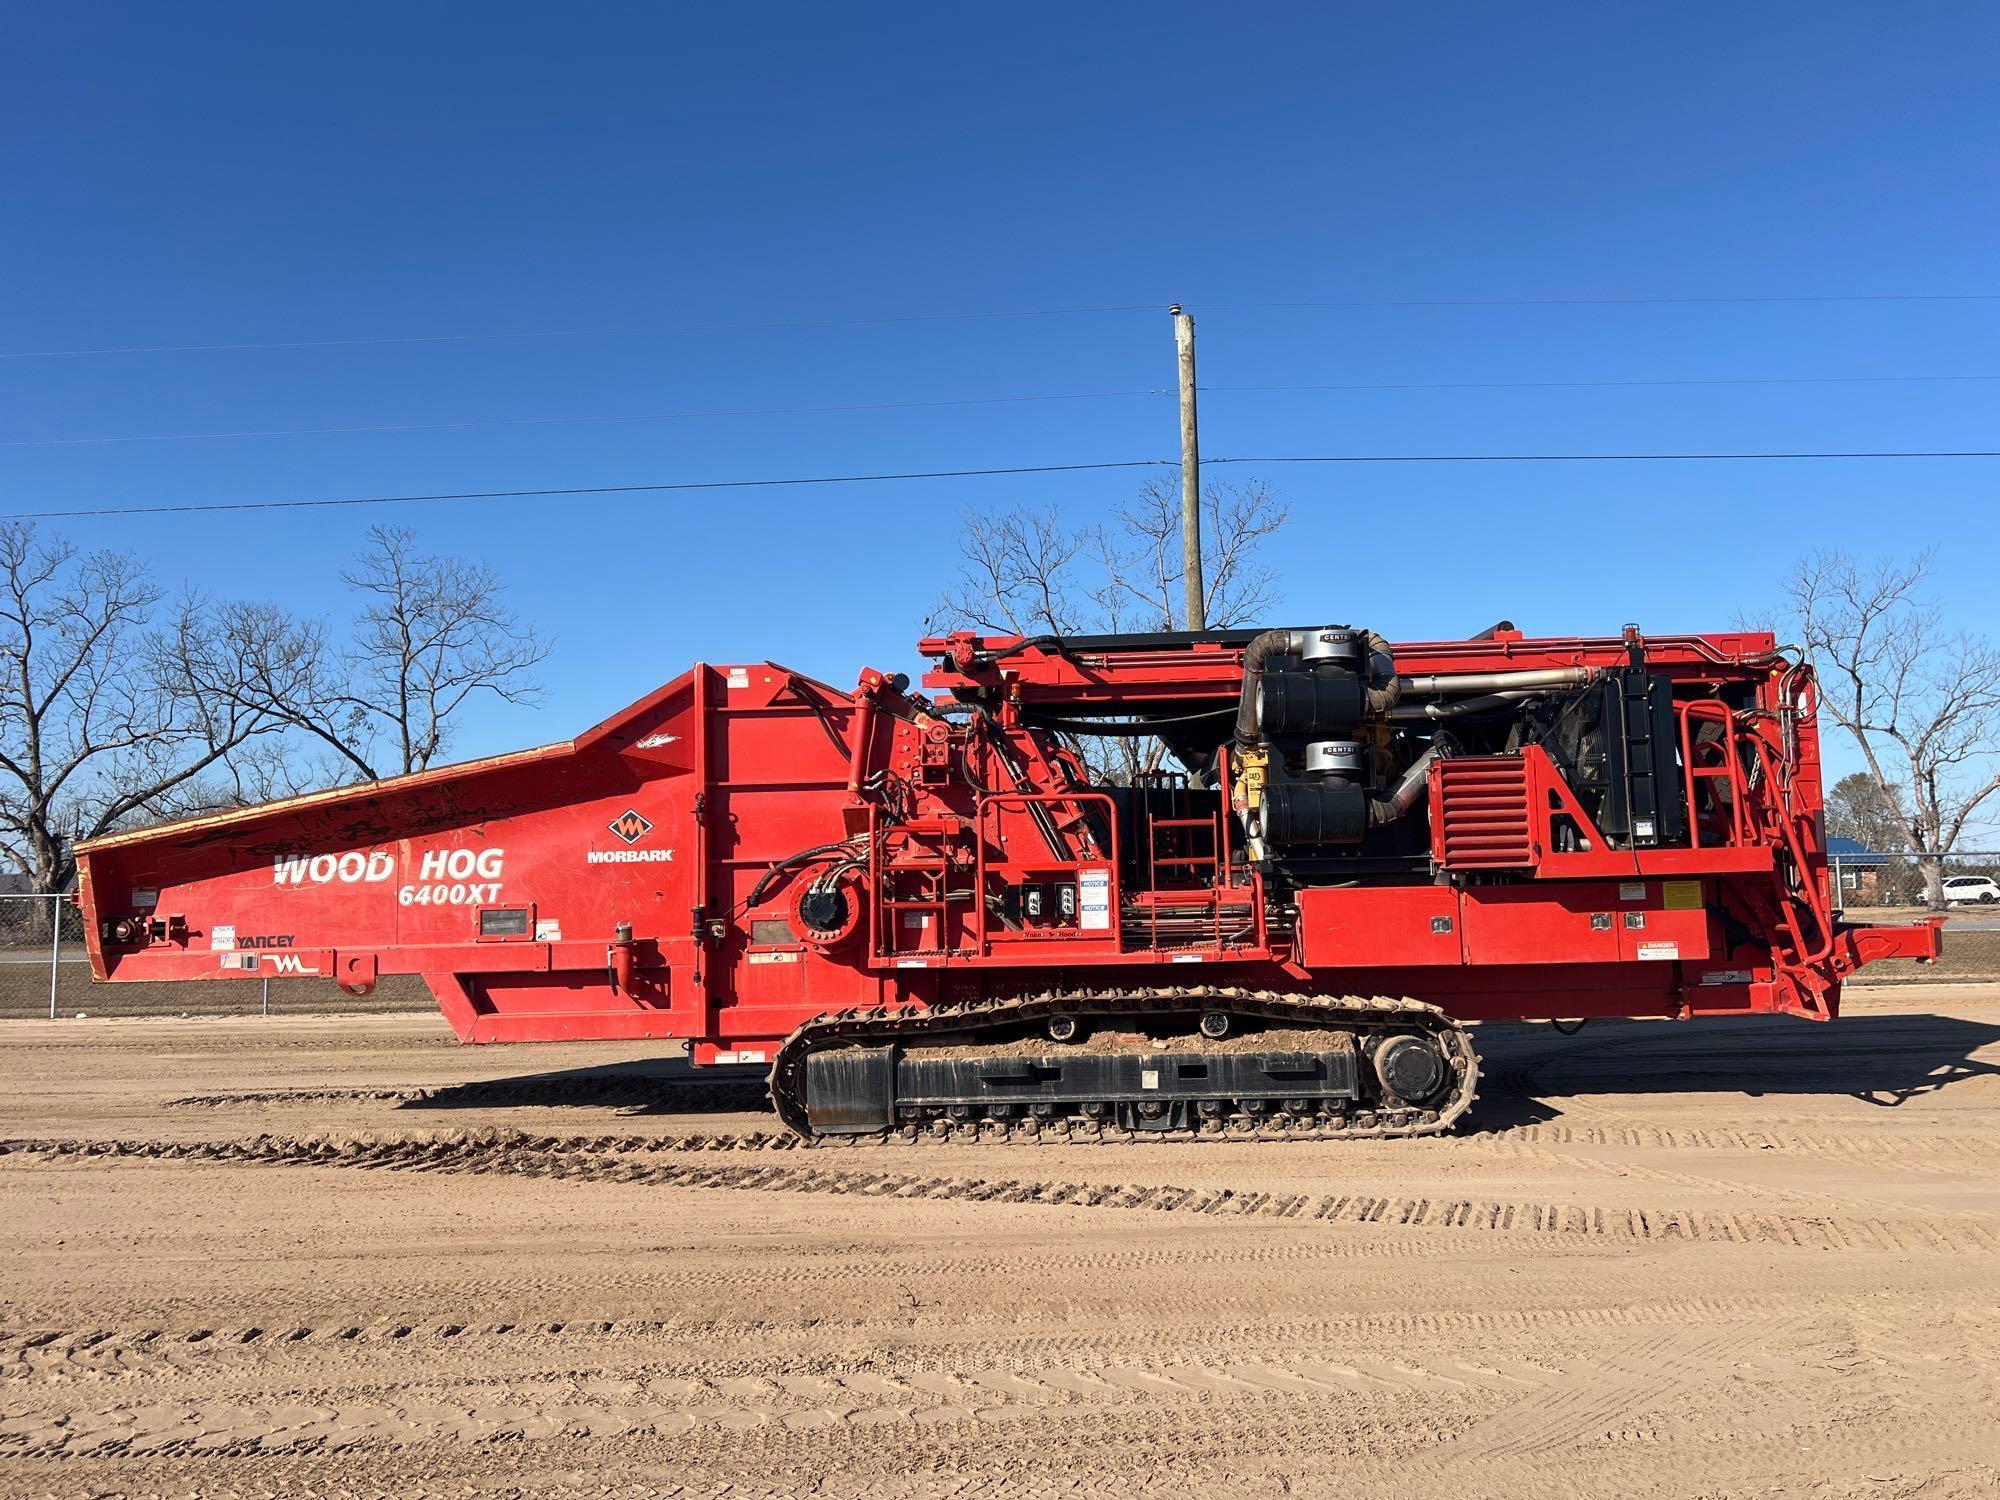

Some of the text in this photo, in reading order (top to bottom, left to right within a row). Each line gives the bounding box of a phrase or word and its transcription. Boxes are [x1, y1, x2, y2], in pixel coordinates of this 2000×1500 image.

[273, 848, 504, 884] WOOD HOG
[587, 850, 673, 864] MORBARK
[399, 883, 502, 906] 6400XT
[237, 935, 295, 949] YANCEY
